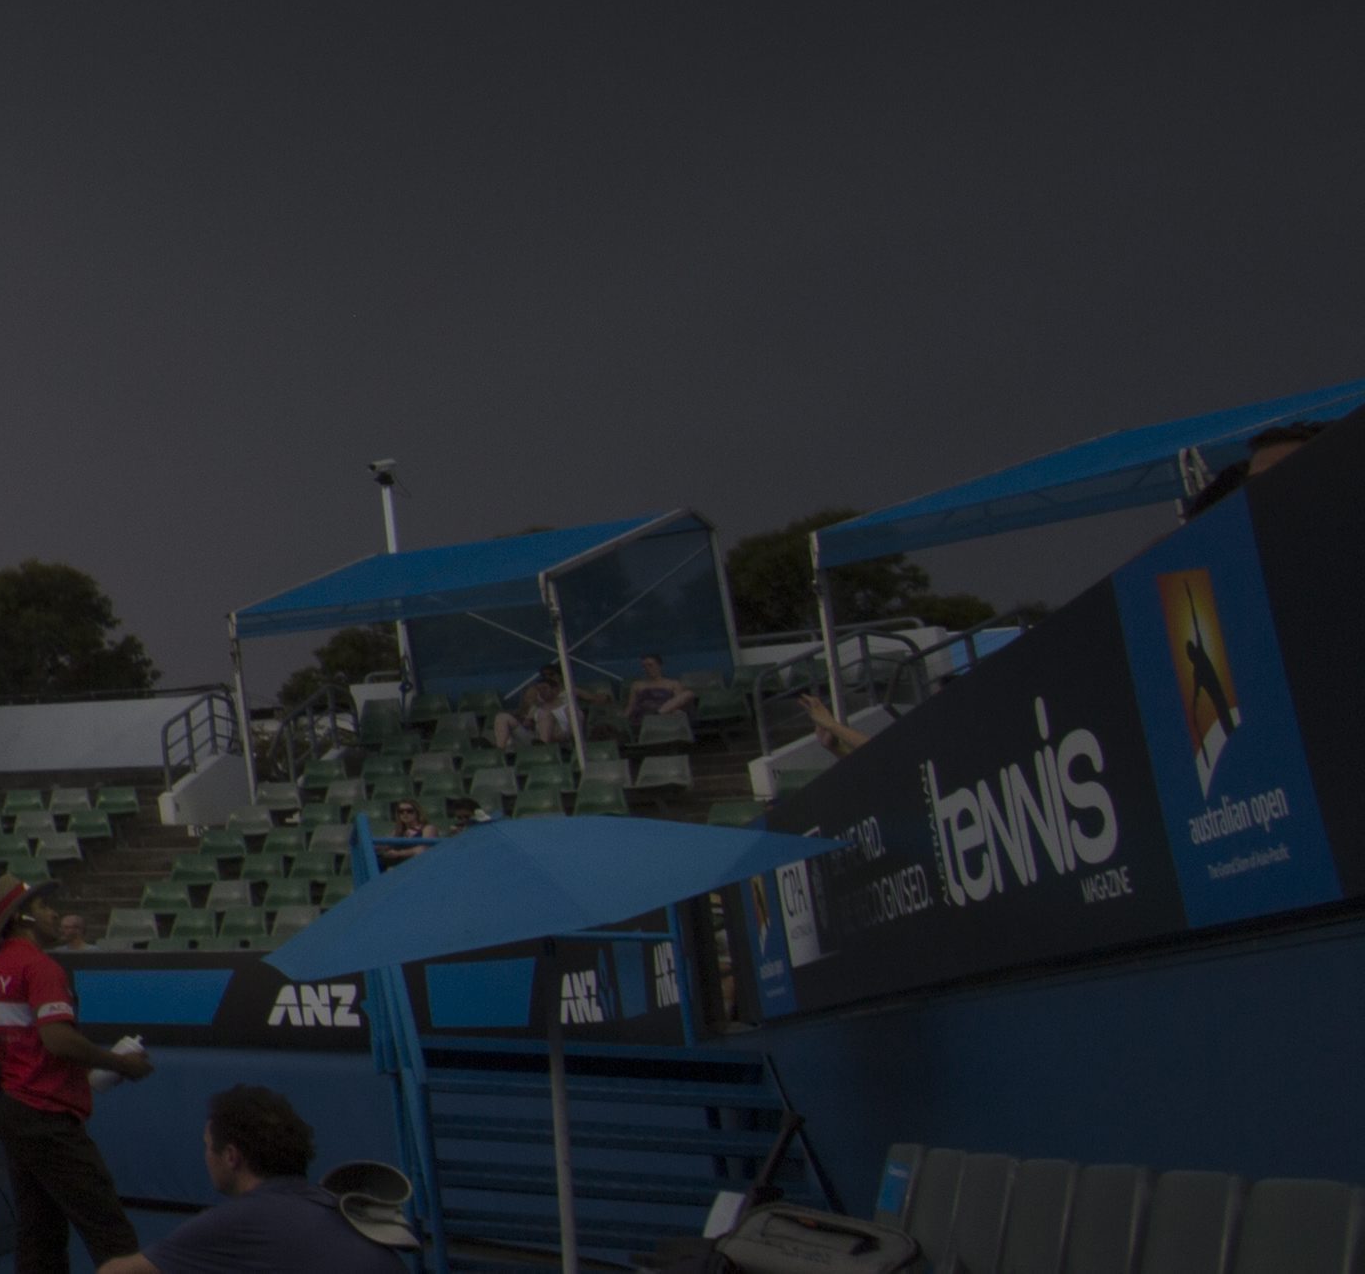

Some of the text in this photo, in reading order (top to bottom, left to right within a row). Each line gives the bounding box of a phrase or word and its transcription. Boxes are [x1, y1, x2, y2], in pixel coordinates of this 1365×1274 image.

[1188, 787, 1290, 845] australian open
[1080, 865, 1134, 904] MAGAZINE
[267, 983, 361, 1027] ANZ
[560, 969, 604, 1025] ANZ
